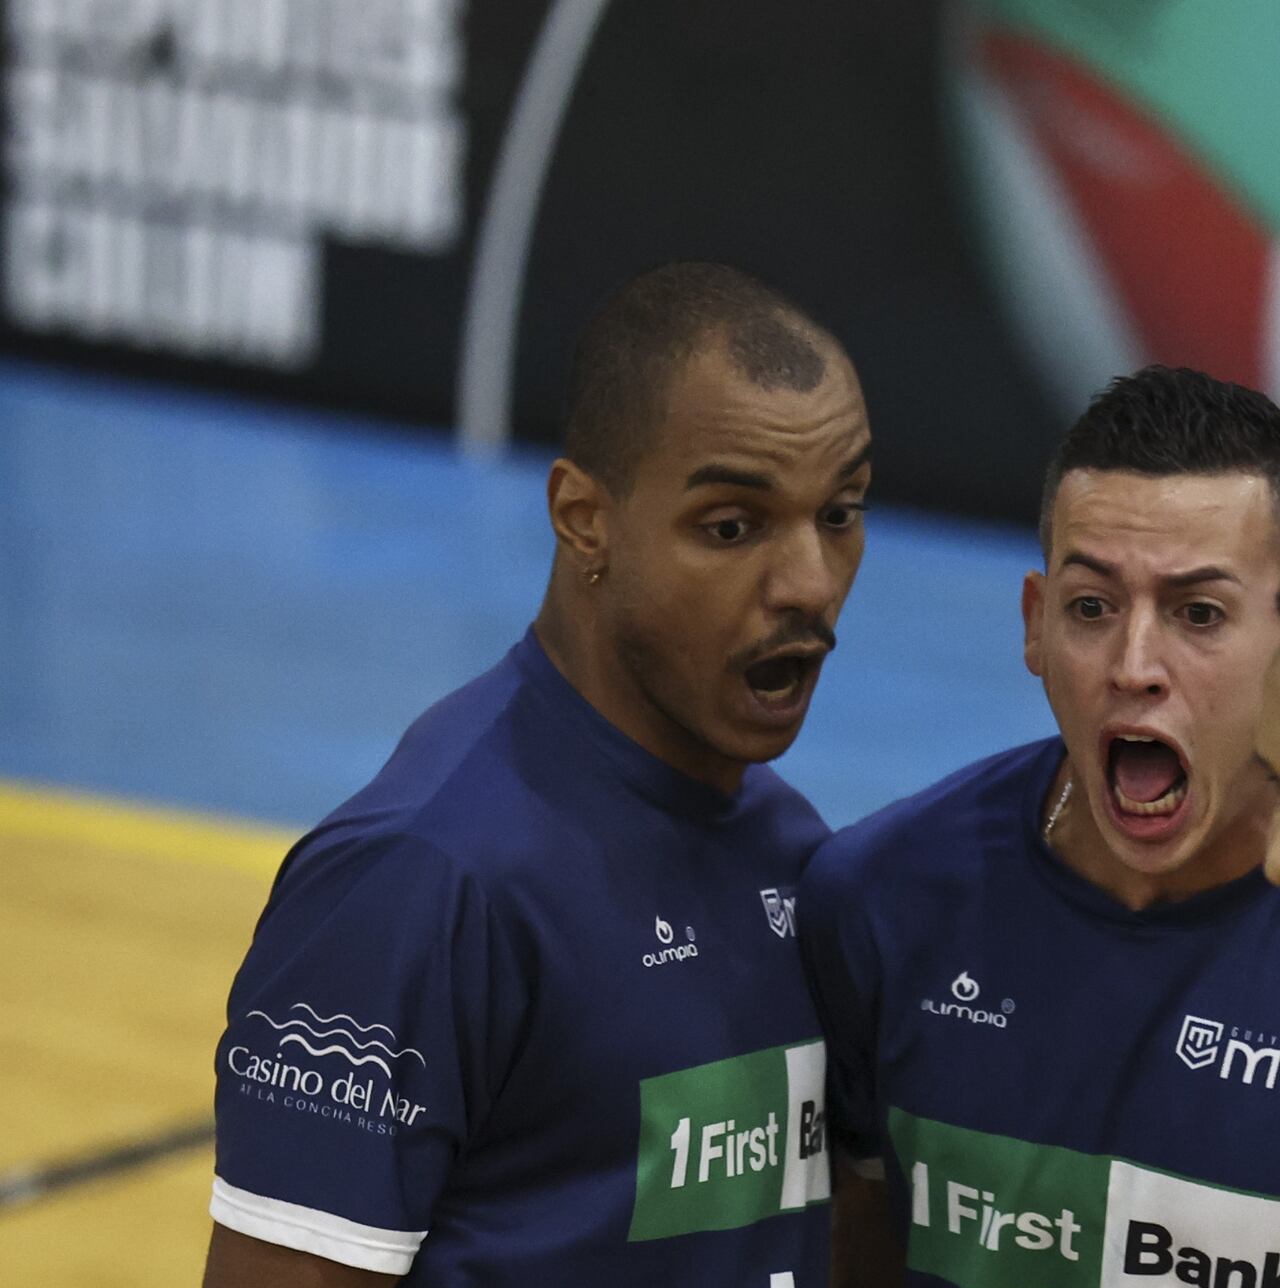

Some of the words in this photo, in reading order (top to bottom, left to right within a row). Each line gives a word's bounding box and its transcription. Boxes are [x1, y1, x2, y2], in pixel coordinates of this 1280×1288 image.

[228, 1046, 324, 1096] Casino
[331, 1072, 374, 1112] del
[258, 1089, 275, 1103] LA
[284, 1097, 352, 1122] CONCHA
[671, 1117, 690, 1189] 1
[698, 1112, 779, 1183] First
[946, 1180, 1082, 1261] First
